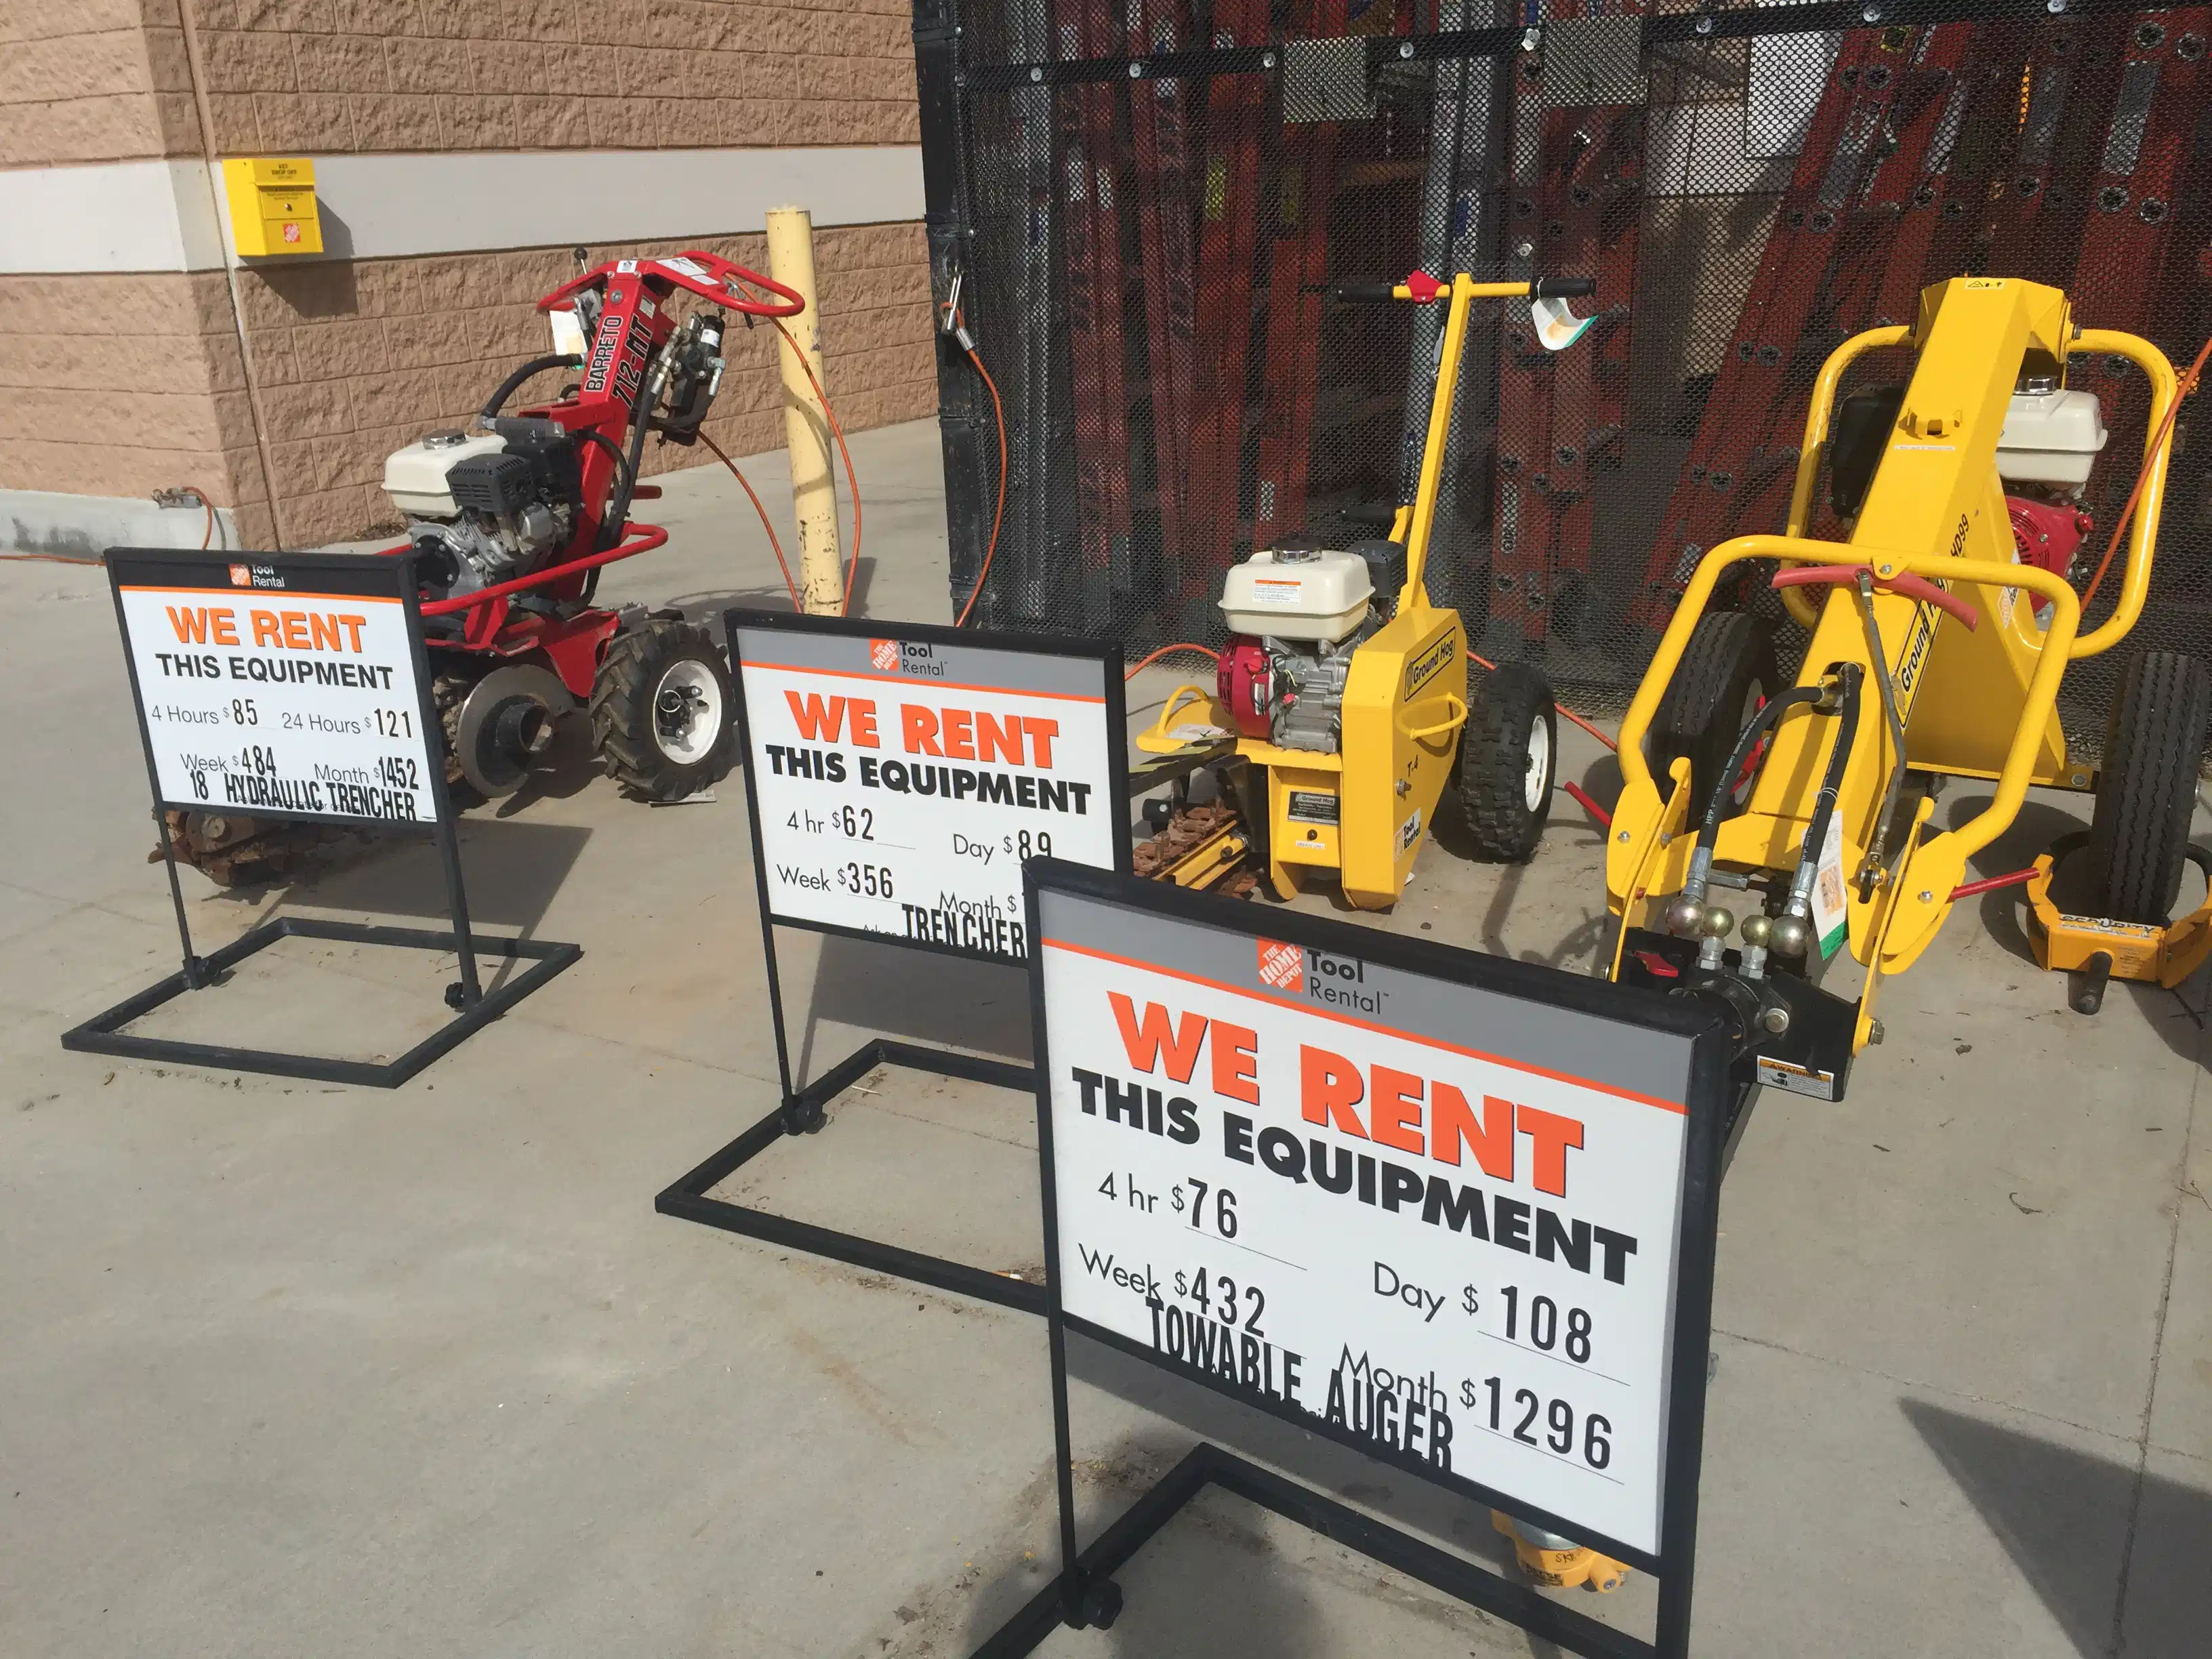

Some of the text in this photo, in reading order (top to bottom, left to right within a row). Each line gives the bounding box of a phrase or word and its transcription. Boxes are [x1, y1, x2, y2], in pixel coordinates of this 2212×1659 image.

[583, 316, 623, 392] BARRETO
[251, 563, 274, 575] Tool
[252, 575, 285, 588] Rental
[165, 606, 367, 653] WE RENT
[899, 641, 933, 658] Tool
[902, 659, 944, 676] Rental
[1414, 640, 1454, 684] Ground Hog
[1901, 616, 1930, 693] Ground
[155, 653, 393, 691] THIS EQUIPMENT
[151, 705, 162, 722] 4
[167, 705, 220, 724] Hours
[281, 712, 304, 730] 24
[309, 714, 361, 735] Hours
[783, 689, 1059, 769] WE RENT
[180, 753, 229, 773] Week
[314, 764, 369, 783] Month
[765, 743, 1092, 816] THIS EQUIPMENT
[190, 771, 209, 800] 18
[224, 773, 323, 812] HYDRAULIC
[325, 781, 417, 821] TRENCHER
[787, 811, 800, 831] 4
[804, 809, 824, 834] hr
[1404, 815, 1414, 838] Tool
[953, 833, 994, 865] Day
[777, 863, 832, 892] Week
[939, 890, 1001, 920] Month
[901, 903, 1029, 959] TRENCHER
[1258, 943, 1303, 985] HOME
[1262, 943, 1281, 962] THE
[1306, 949, 1364, 983] Tool
[1275, 962, 1303, 989] DEPOT
[1309, 976, 1381, 1015] Rental
[1106, 990, 1584, 1198] WE RENT
[1071, 1066, 1637, 1285] THIS EQUIPMENT
[1098, 1171, 1117, 1201] 4
[1128, 1172, 1159, 1214] hr
[1078, 1242, 1162, 1301] Week
[1374, 1261, 1446, 1322] Day
[1145, 1296, 1302, 1405] TOWABLE
[1326, 1368, 1453, 1472] AUGER
[1338, 1342, 1447, 1414] Month
